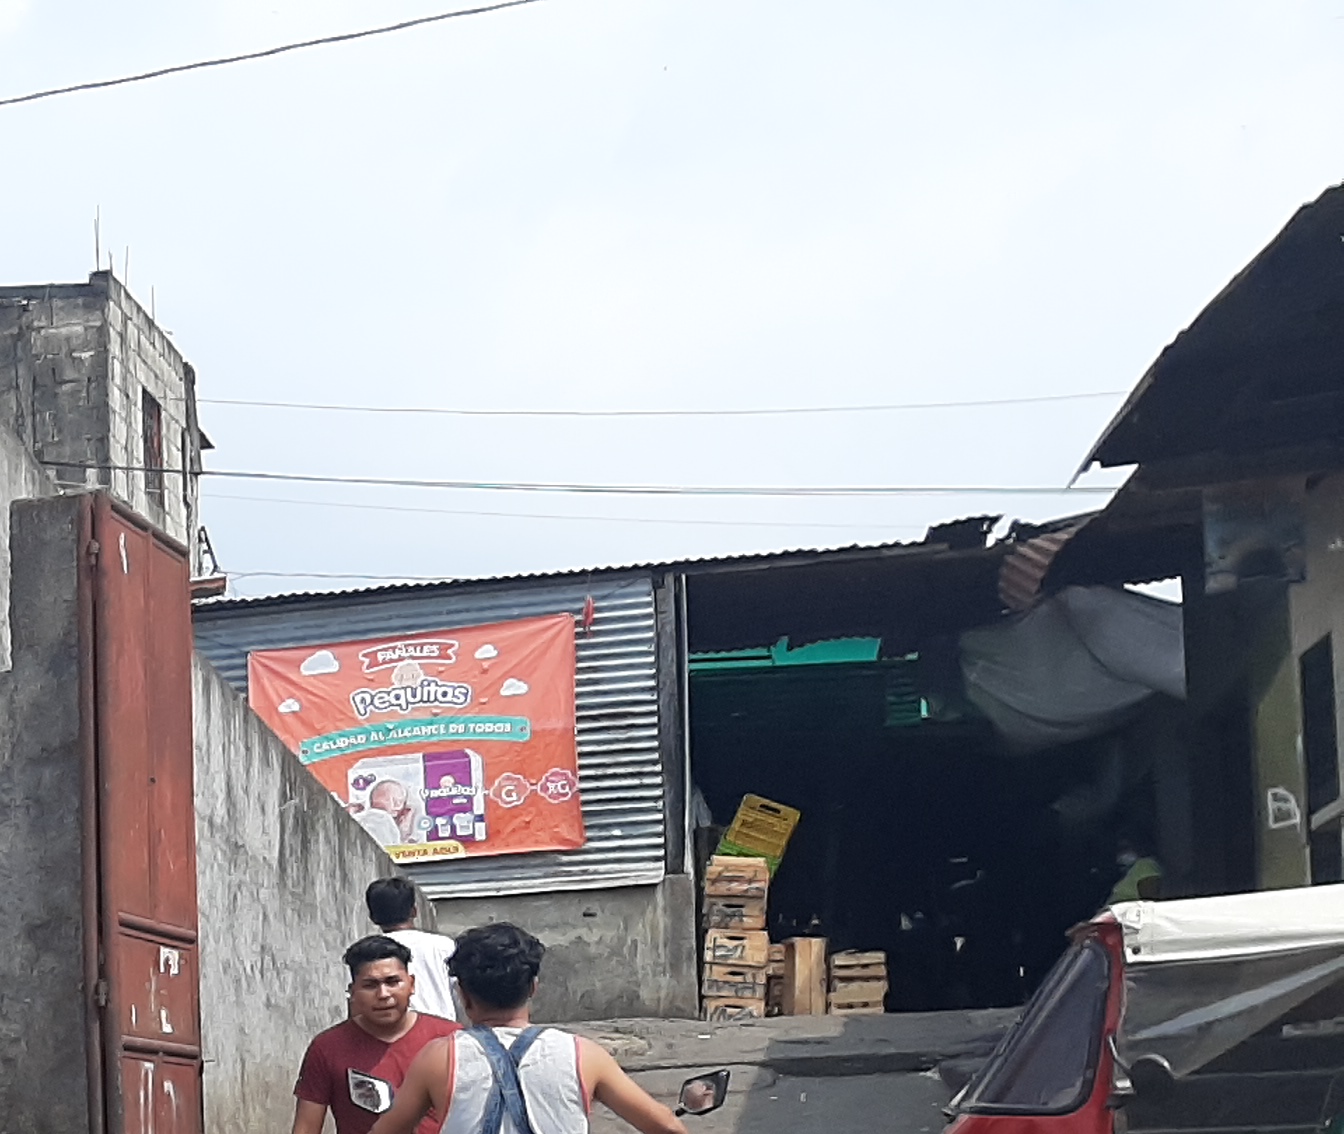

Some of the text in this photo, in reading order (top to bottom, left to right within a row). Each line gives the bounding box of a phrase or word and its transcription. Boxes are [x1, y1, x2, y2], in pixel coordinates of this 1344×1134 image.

[376, 643, 440, 663] PAÑALES
[352, 679, 471, 719] Pequitas
[313, 721, 512, 753] CALIDAD AL ALCANCE DE TODOS
